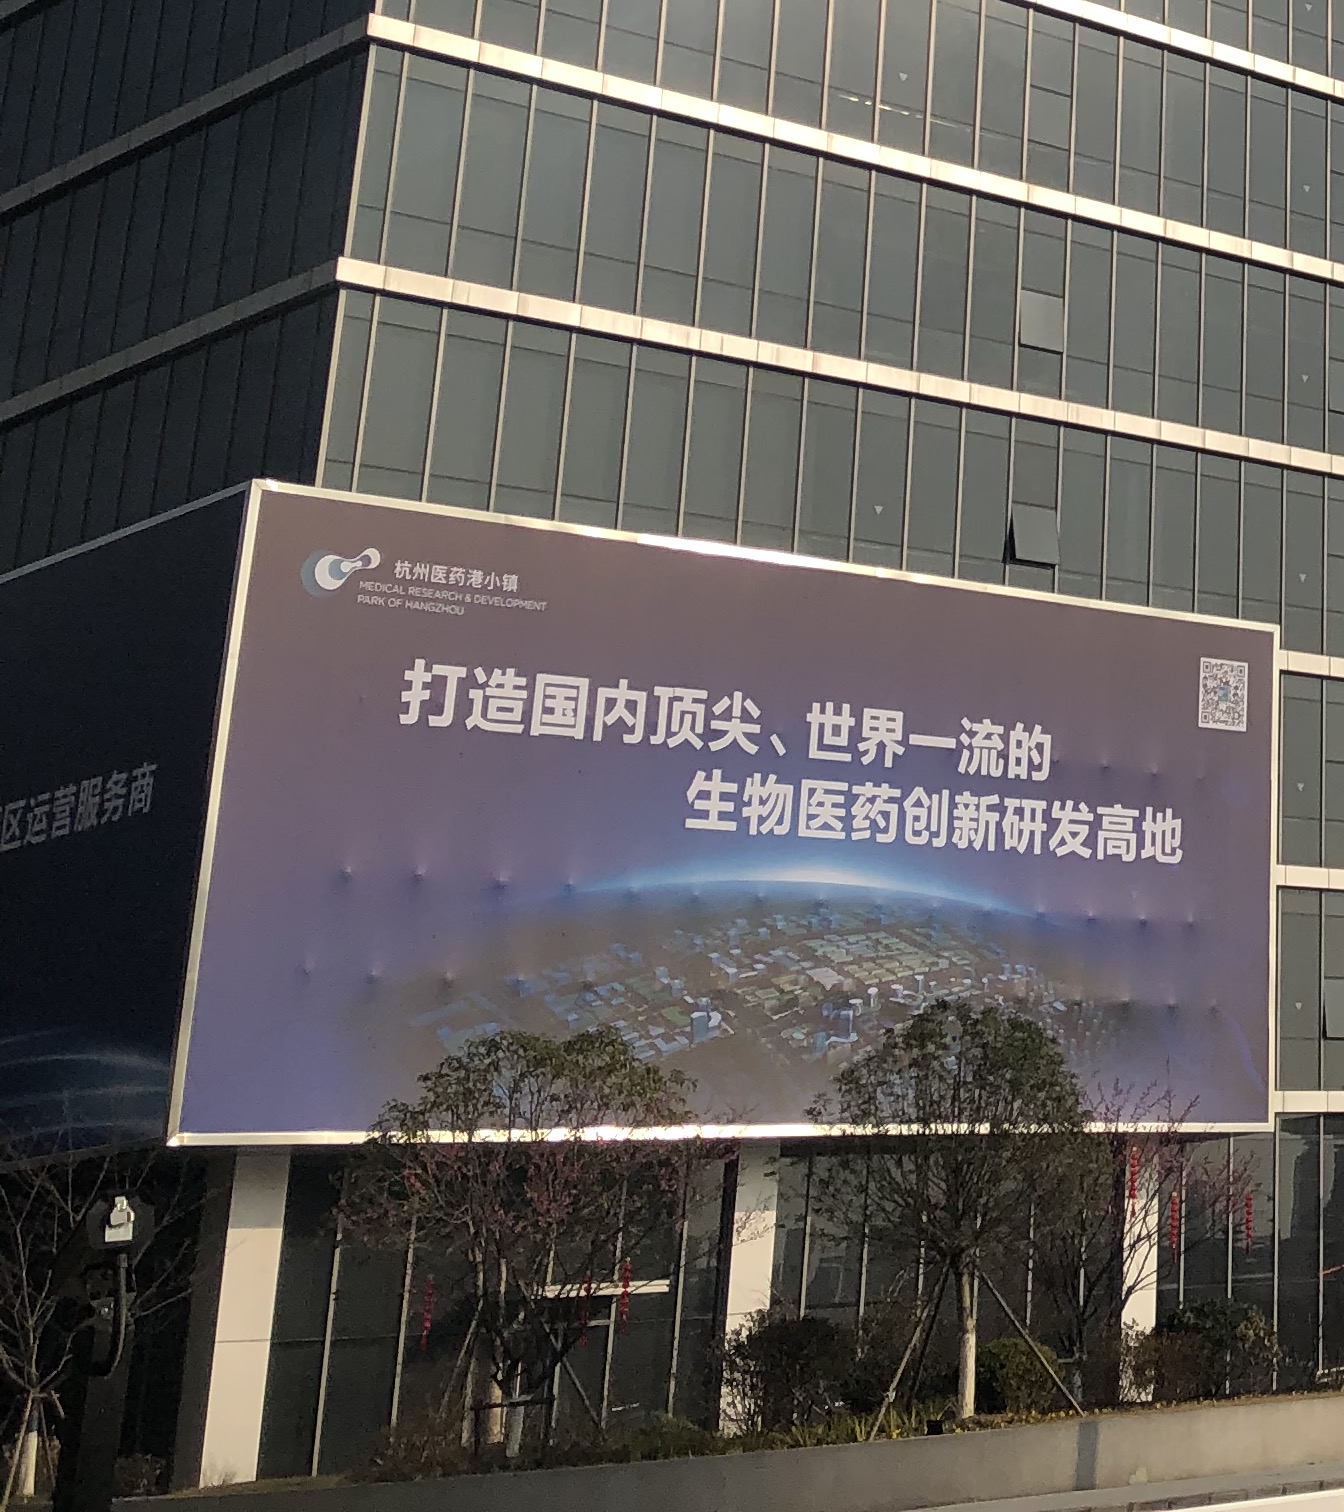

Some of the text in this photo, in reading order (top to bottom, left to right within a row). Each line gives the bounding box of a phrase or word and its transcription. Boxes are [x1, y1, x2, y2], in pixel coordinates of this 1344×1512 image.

[357, 594, 465, 616] PARK OF HANGZHOU
[359, 581, 406, 596] MEDICAL
[408, 586, 463, 602] RESEARCH
[473, 594, 548, 612] DEVELOPMENT
[393, 560, 519, 592] 杭州医药港小镇
[398, 658, 1053, 782] 打造国内顶尖、世界一流的
[0, 761, 158, 853] 区运营服务商
[685, 768, 1184, 865] 生物医药创新研发高地
